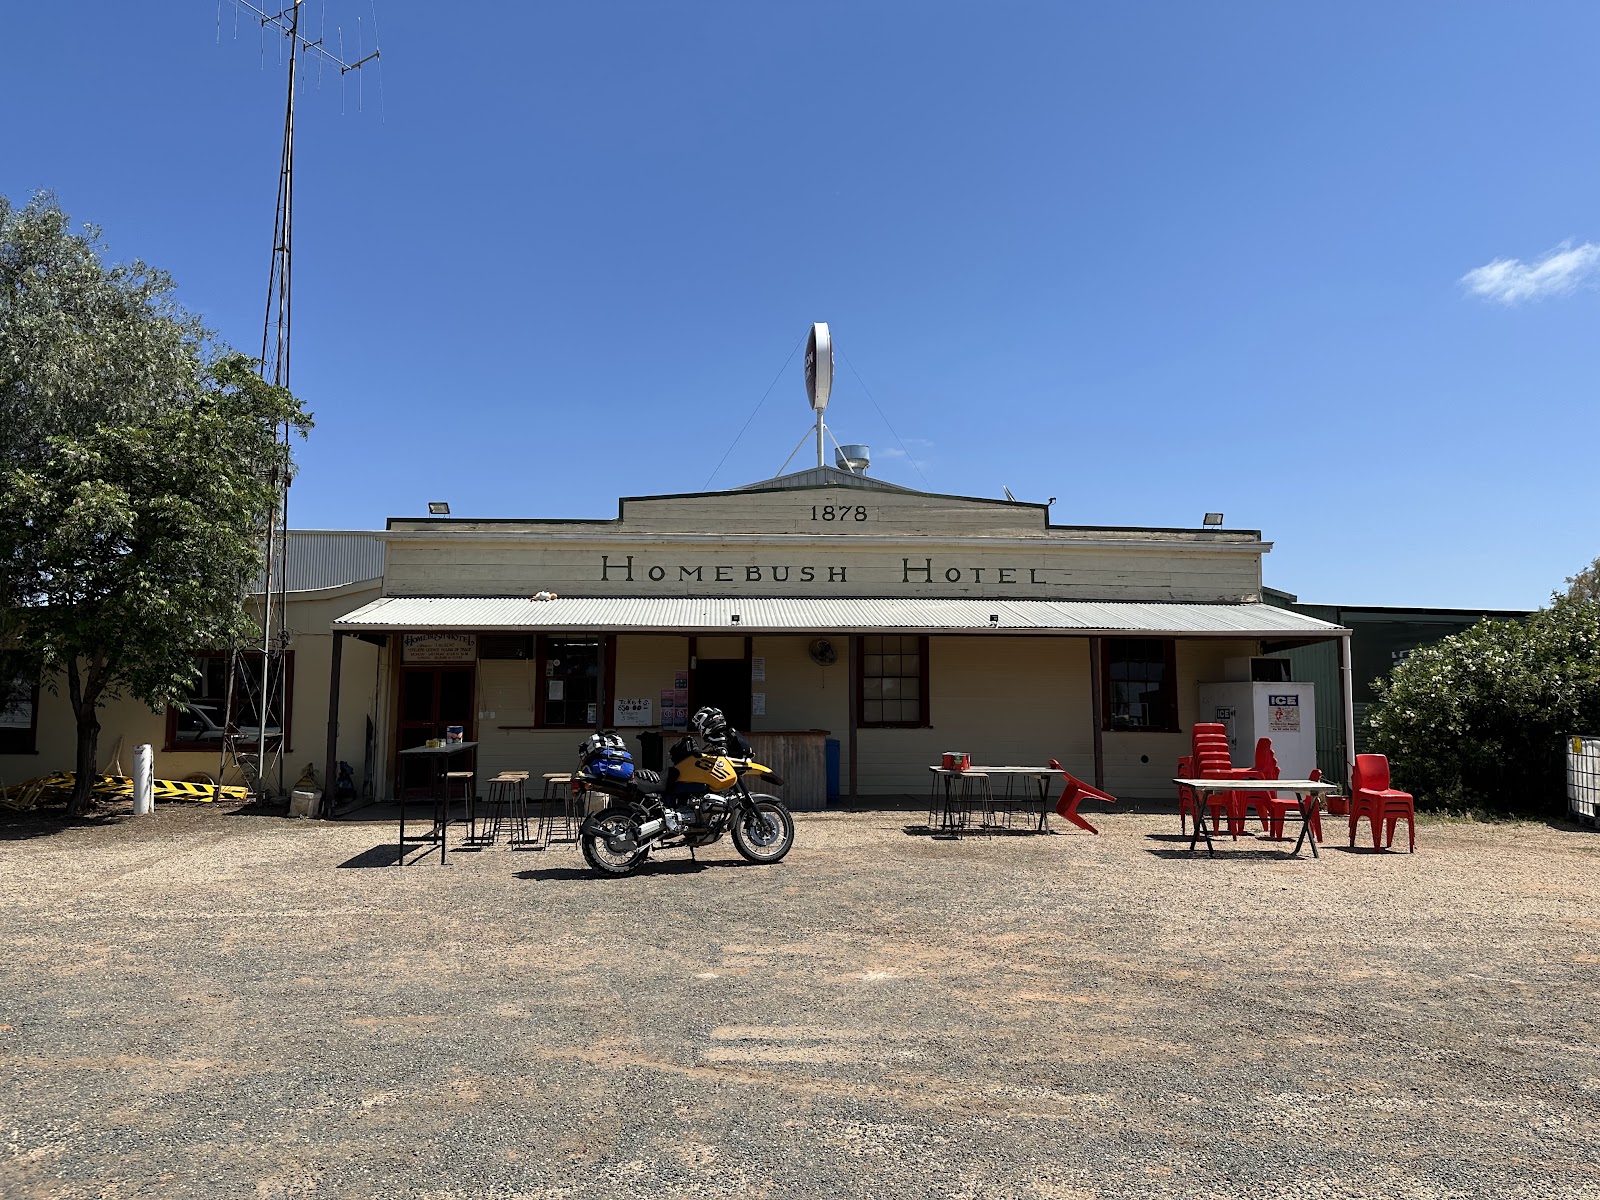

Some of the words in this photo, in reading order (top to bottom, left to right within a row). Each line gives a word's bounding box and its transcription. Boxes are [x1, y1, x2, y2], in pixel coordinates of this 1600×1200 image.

[810, 505, 868, 522] 1878
[601, 555, 848, 583] HOMEBUSH
[902, 558, 1047, 584] HOTEL
[1270, 696, 1297, 705] ICE
[1217, 709, 1230, 718] ICE
